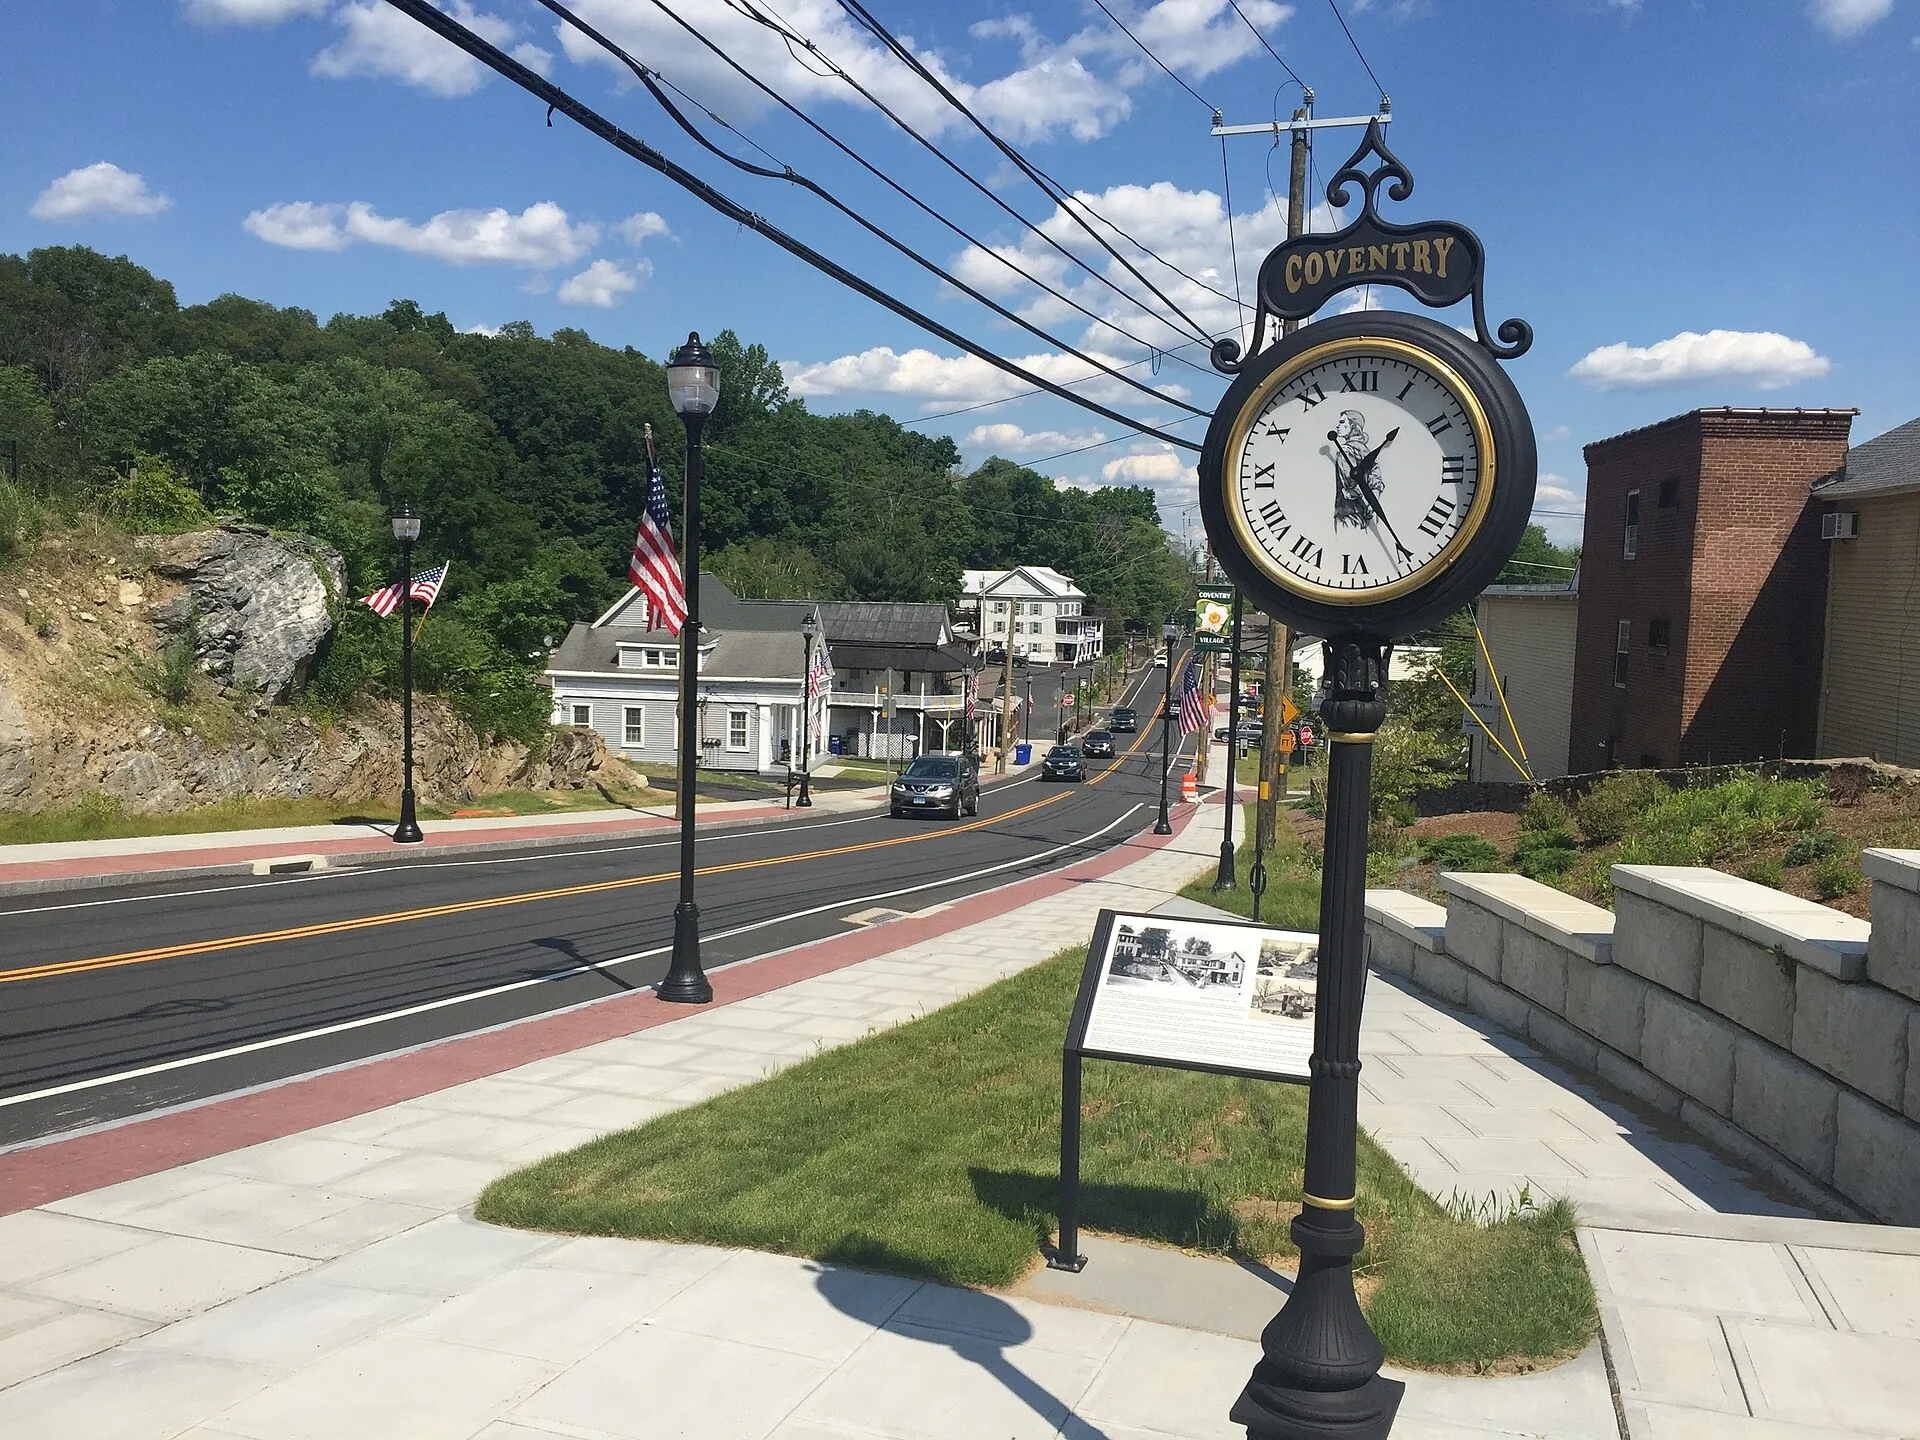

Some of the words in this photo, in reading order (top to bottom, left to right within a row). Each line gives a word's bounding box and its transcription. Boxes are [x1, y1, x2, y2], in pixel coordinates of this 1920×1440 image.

[1285, 237, 1455, 294] COVENTRY
[1340, 370, 1379, 393] XII
[1396, 380, 1415, 401] I
[1295, 381, 1328, 413] XI
[1266, 421, 1291, 444] X
[1425, 412, 1453, 438] II
[1254, 462, 1275, 490] IX
[1441, 455, 1464, 485] III
[1259, 499, 1292, 541] VIII
[1417, 494, 1456, 538] IIII
[1289, 534, 1323, 569] VII
[1341, 554, 1369, 574] VI
[1198, 591, 1231, 599] COVENTRY
[1199, 636, 1225, 644] VILLAGE
[1281, 738, 1289, 746] FT
